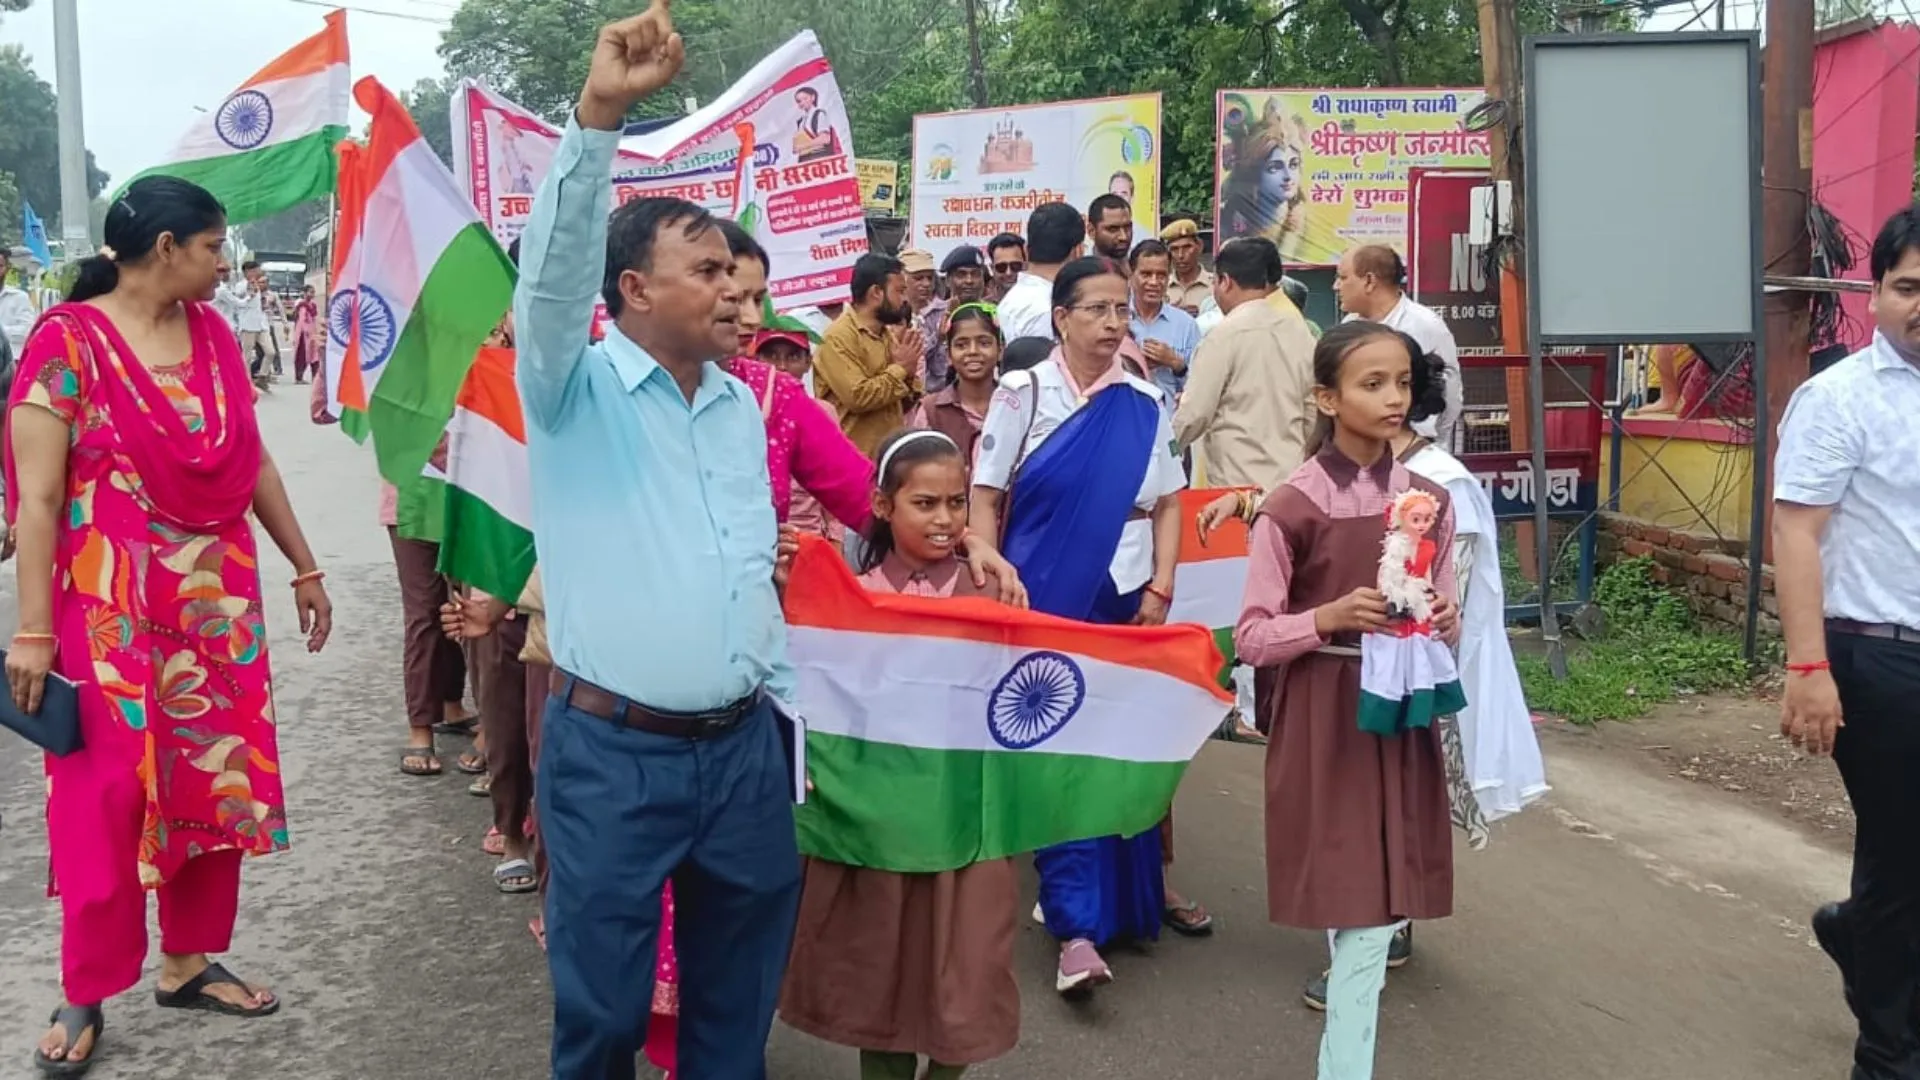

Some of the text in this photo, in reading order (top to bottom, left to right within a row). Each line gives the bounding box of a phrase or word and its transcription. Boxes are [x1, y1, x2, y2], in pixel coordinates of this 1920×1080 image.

[1312, 94, 1457, 118] श्री राधाकृष्ण स्वामी
[1311, 120, 1400, 168] श्रीकृष्ण
[783, 154, 849, 186] सरकार
[1311, 184, 1345, 203] ढेरों
[1451, 304, 1476, 320] 8.00
